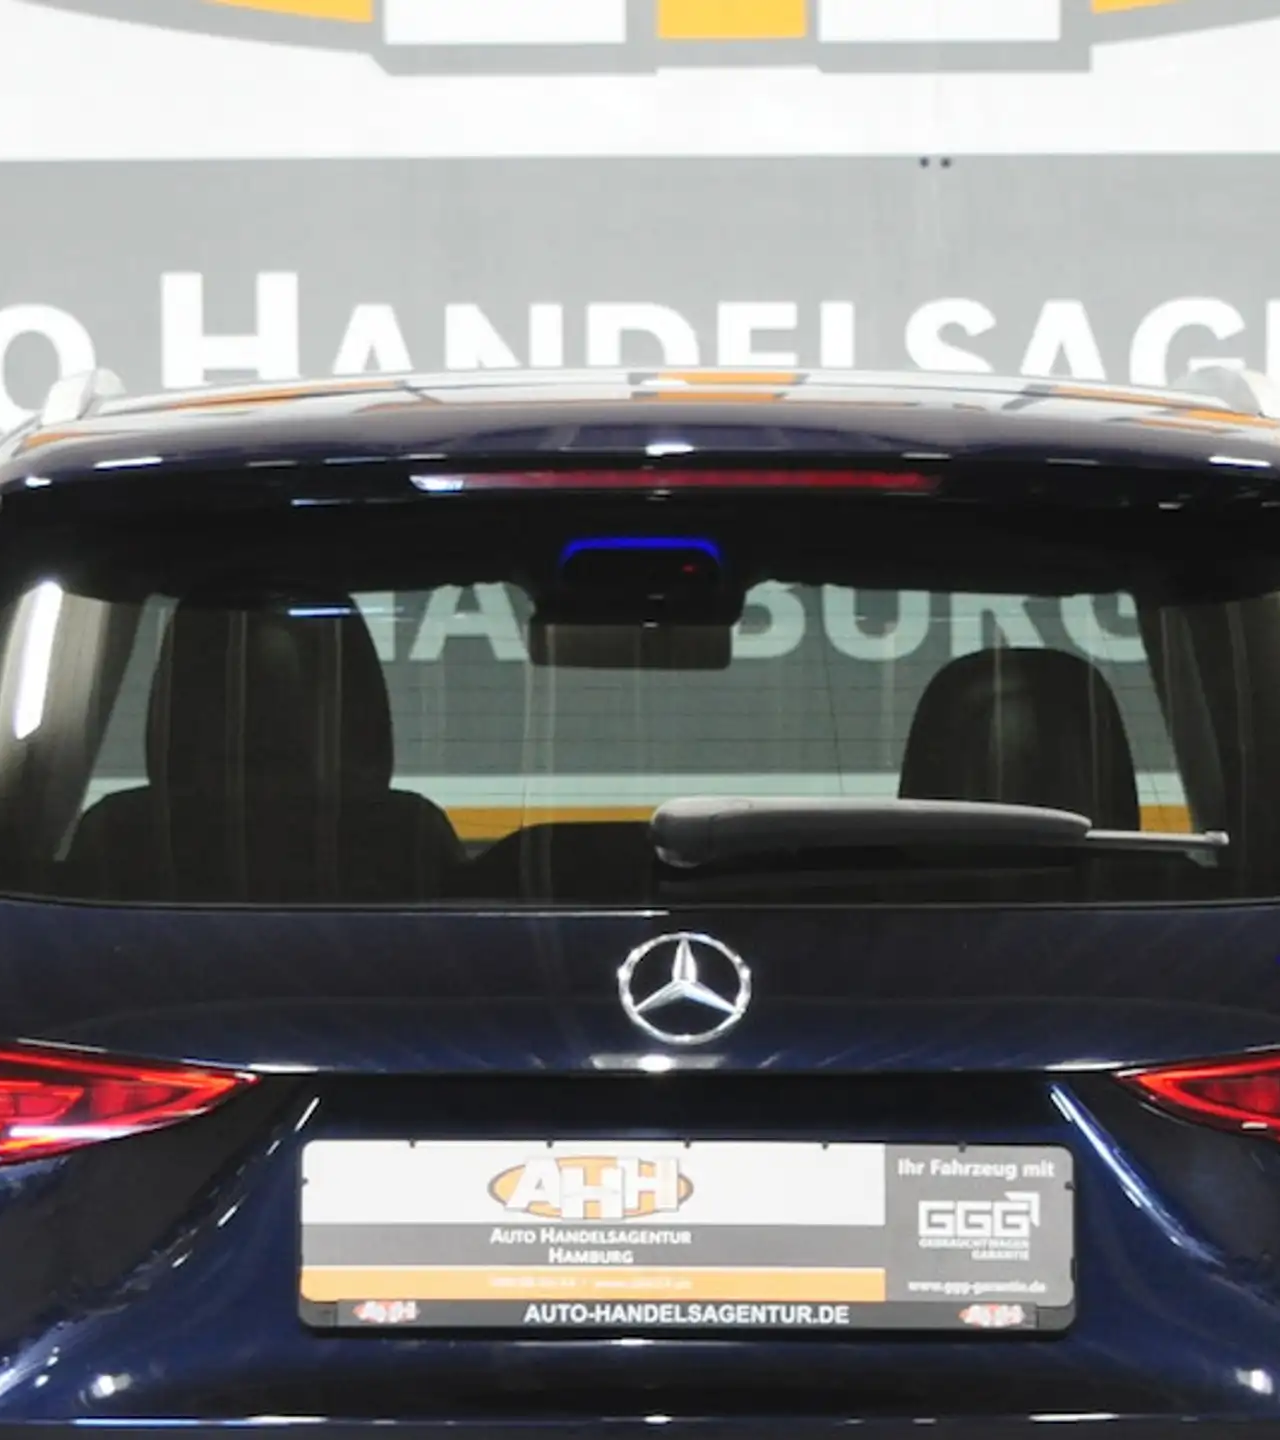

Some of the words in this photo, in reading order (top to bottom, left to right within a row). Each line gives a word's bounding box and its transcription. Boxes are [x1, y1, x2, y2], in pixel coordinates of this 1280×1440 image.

[898, 1158, 925, 1176] Ihr
[930, 1158, 1018, 1181] Fahrzeug
[1022, 1159, 1055, 1178] mit
[918, 1200, 1030, 1238] GGG
[490, 1227, 536, 1245] AUTO
[539, 1226, 692, 1245] HANDELSAGENTUR
[548, 1246, 634, 1264] HAMBURG
[523, 1301, 851, 1325] AUTO-HANDELSAGENTUR.DE
